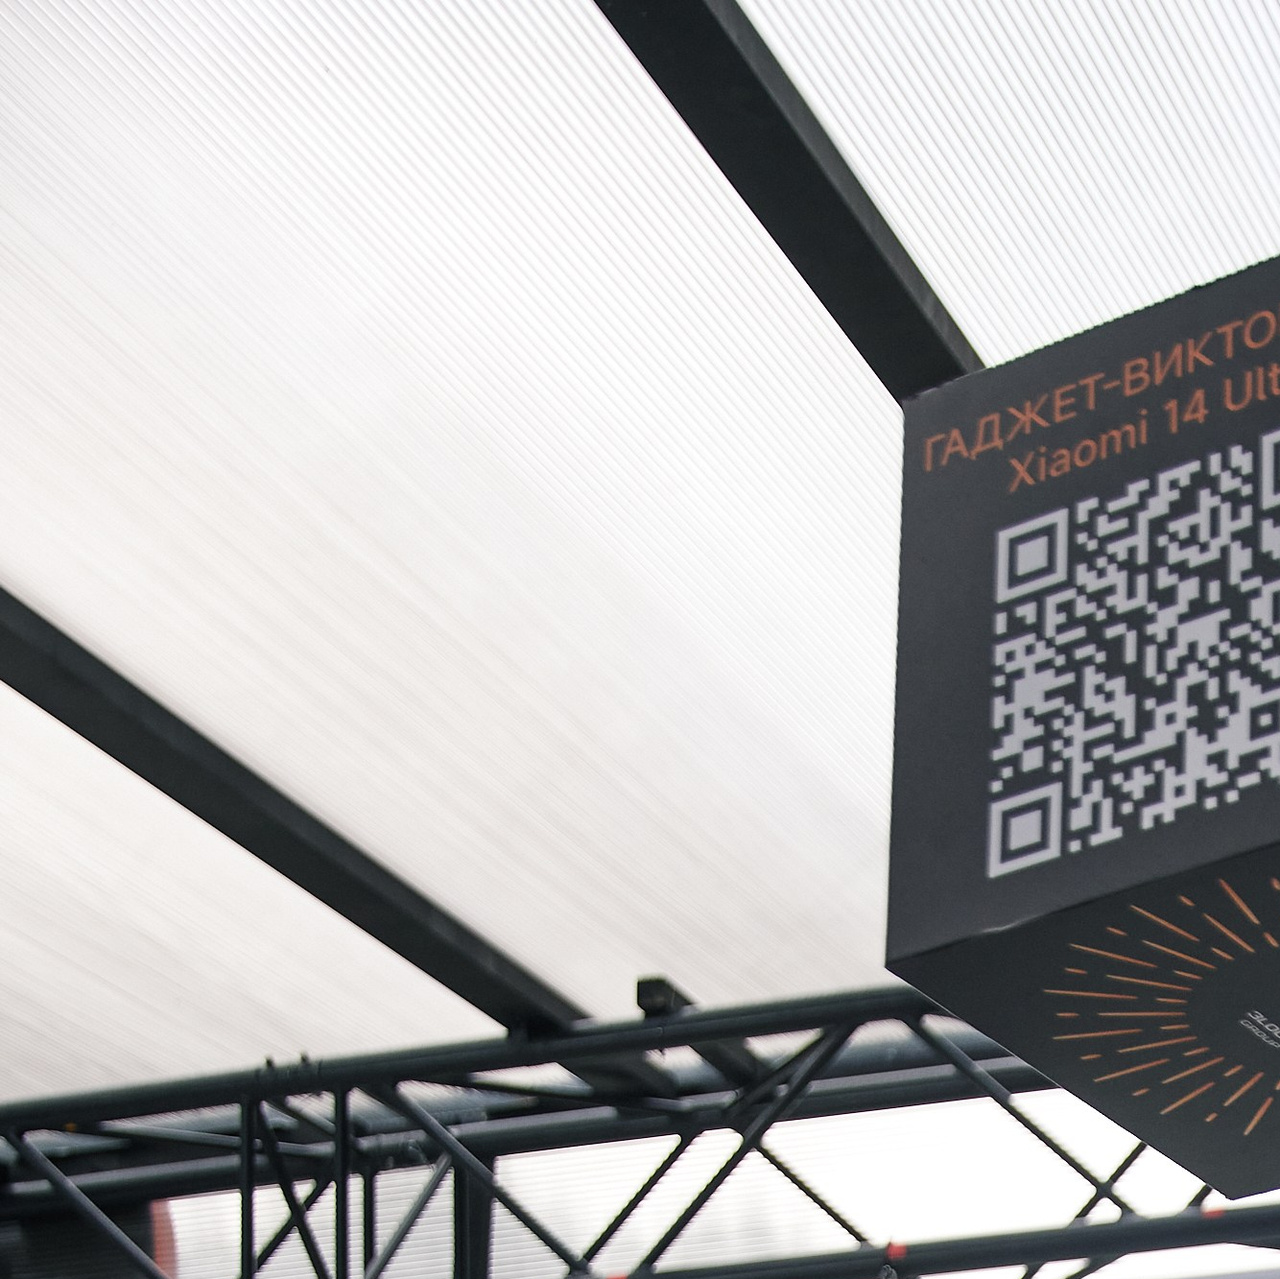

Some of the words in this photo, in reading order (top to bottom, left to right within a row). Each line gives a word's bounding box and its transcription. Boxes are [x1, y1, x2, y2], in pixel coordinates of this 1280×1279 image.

[1010, 412, 1150, 493] Xiaomi
[1168, 394, 1208, 441] 14
[1239, 1019, 1280, 1049] GROUP
